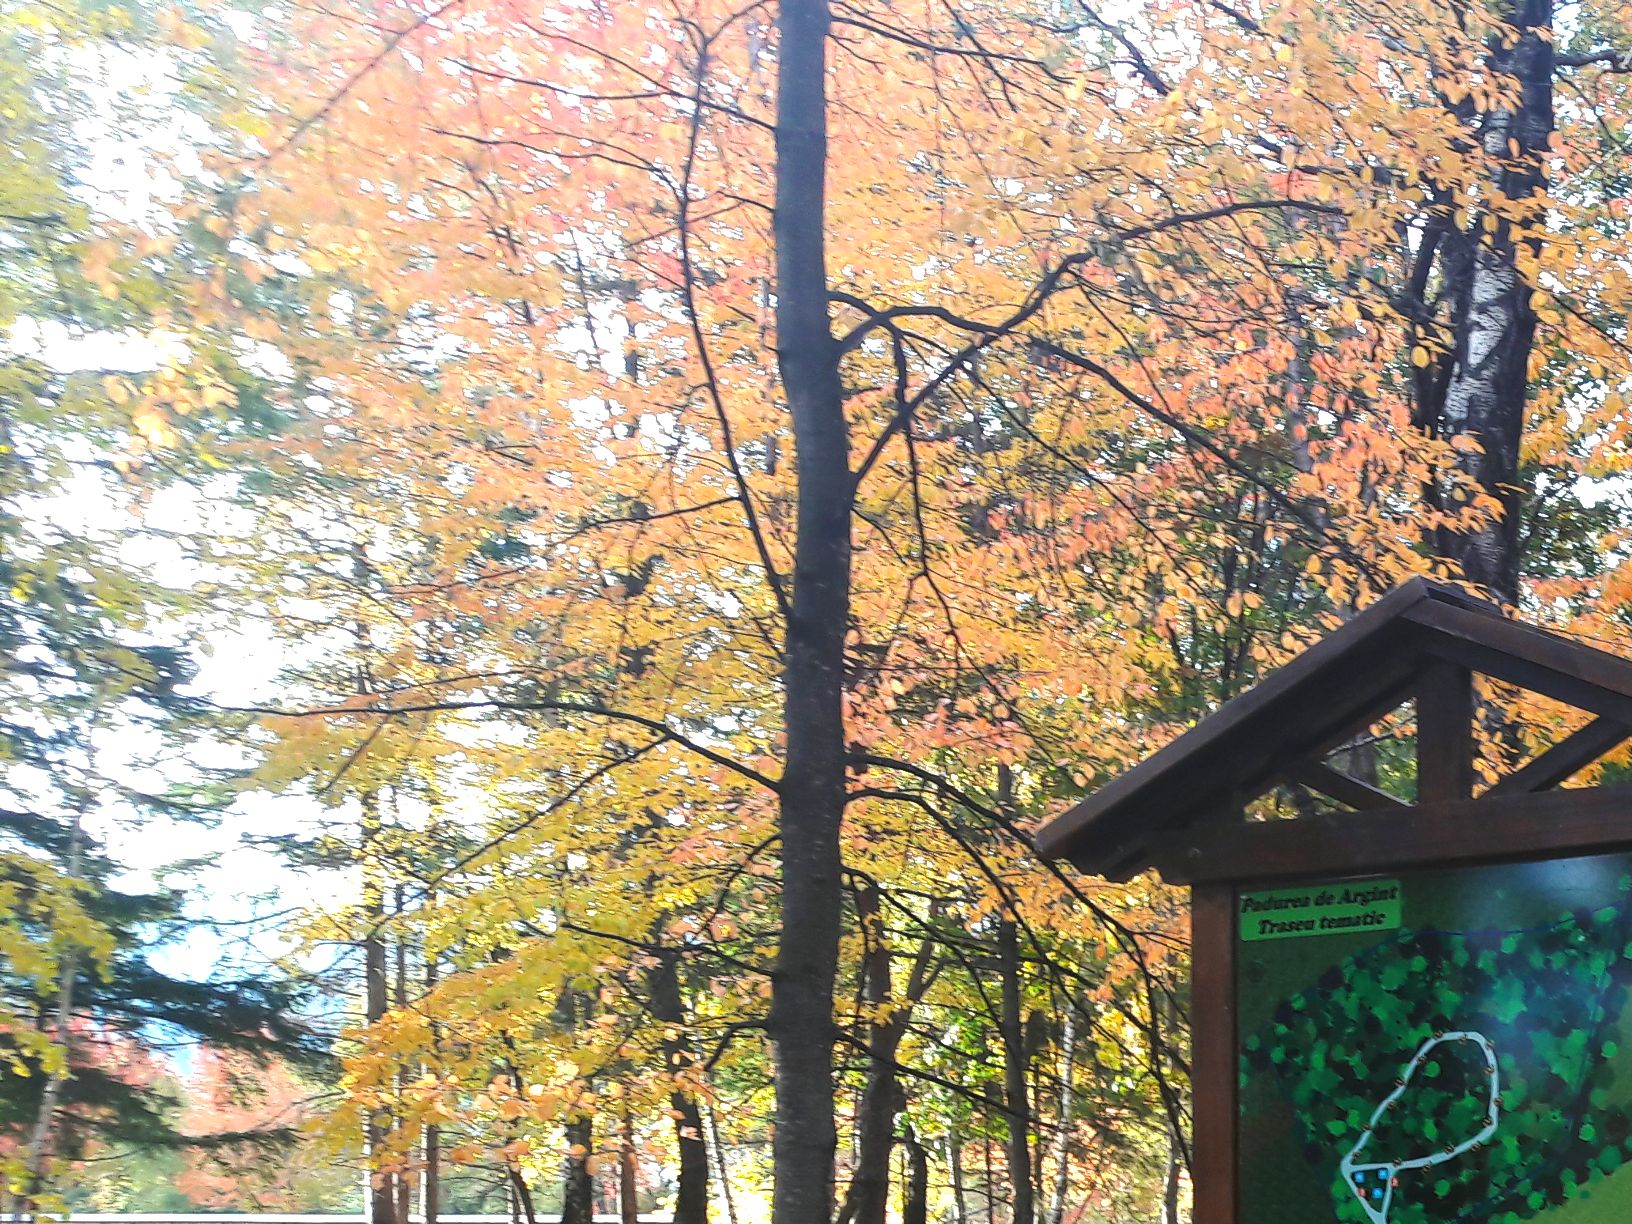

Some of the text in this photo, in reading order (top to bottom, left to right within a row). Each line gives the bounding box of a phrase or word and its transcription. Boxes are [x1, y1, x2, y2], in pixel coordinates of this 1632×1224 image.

[1315, 890, 1336, 906] de
[1337, 886, 1398, 906] Argint
[1259, 911, 1386, 934] Traseu tematic
